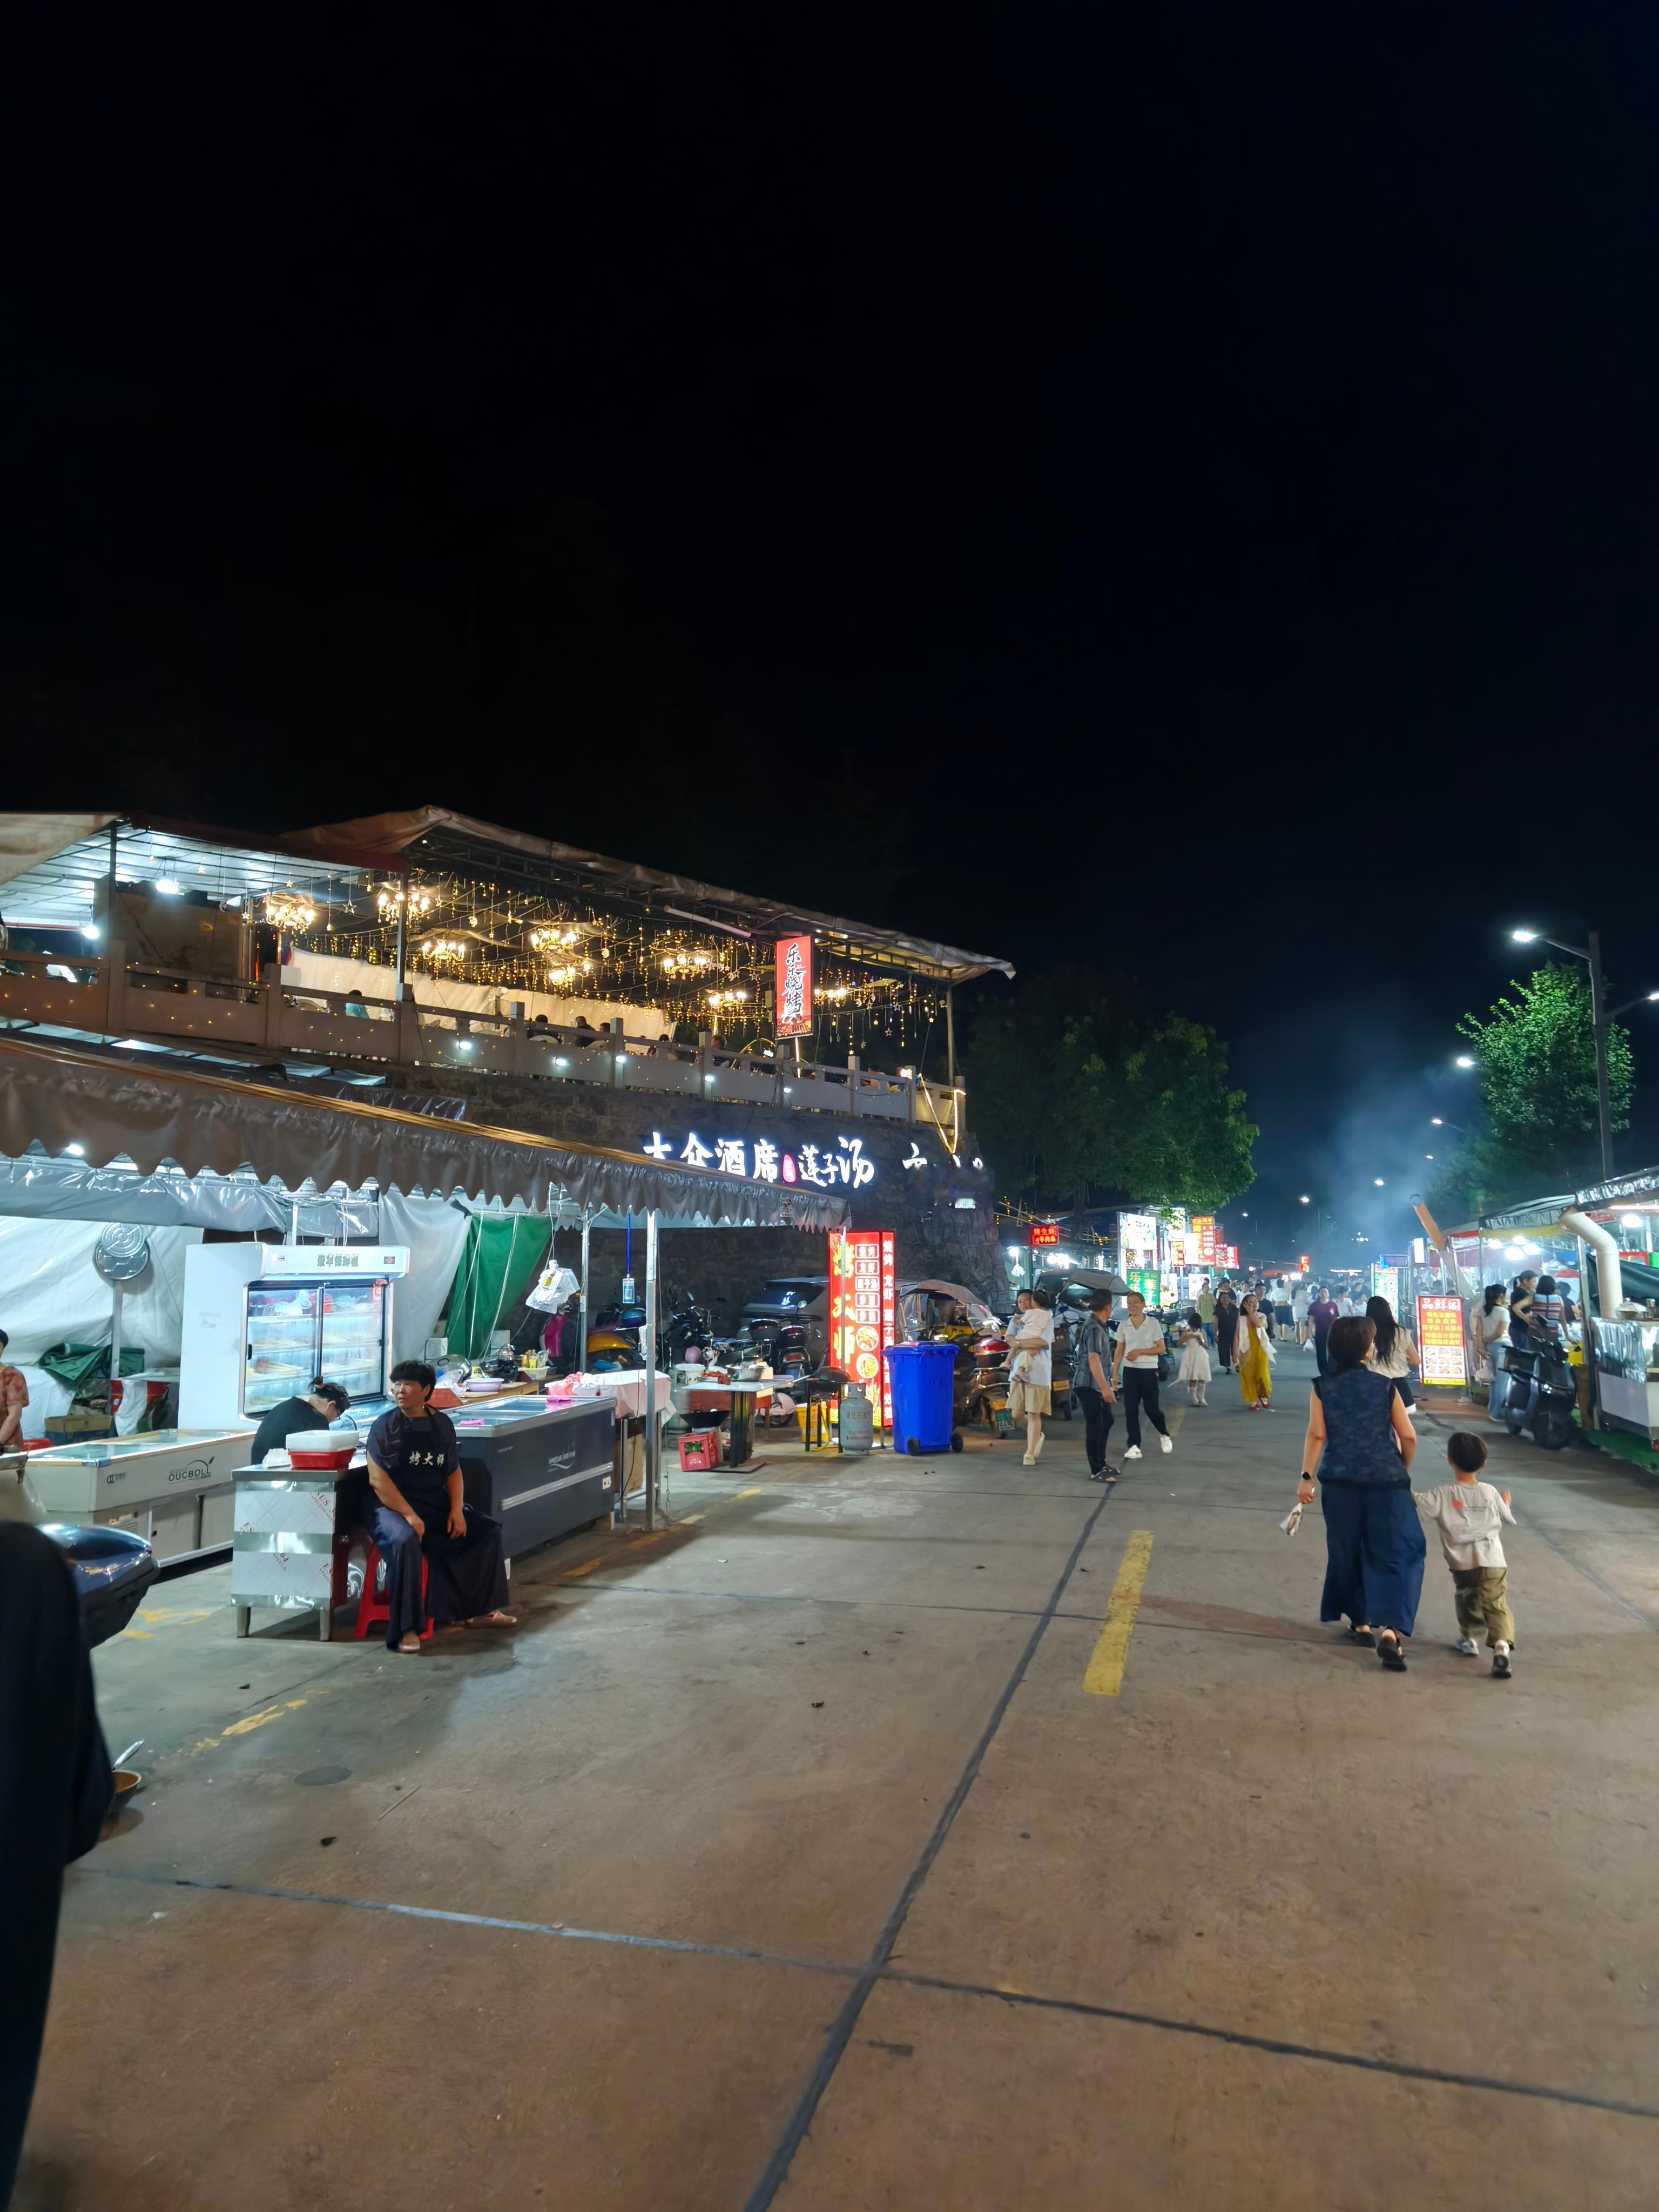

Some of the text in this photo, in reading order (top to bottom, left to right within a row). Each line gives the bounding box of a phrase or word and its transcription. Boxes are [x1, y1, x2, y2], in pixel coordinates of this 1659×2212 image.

[785, 943, 805, 1015] 乐乐烧烤
[798, 1136, 874, 1189] 莲子汤
[884, 1274, 893, 1300] 龙虾
[409, 1451, 444, 1467] 烤大师
